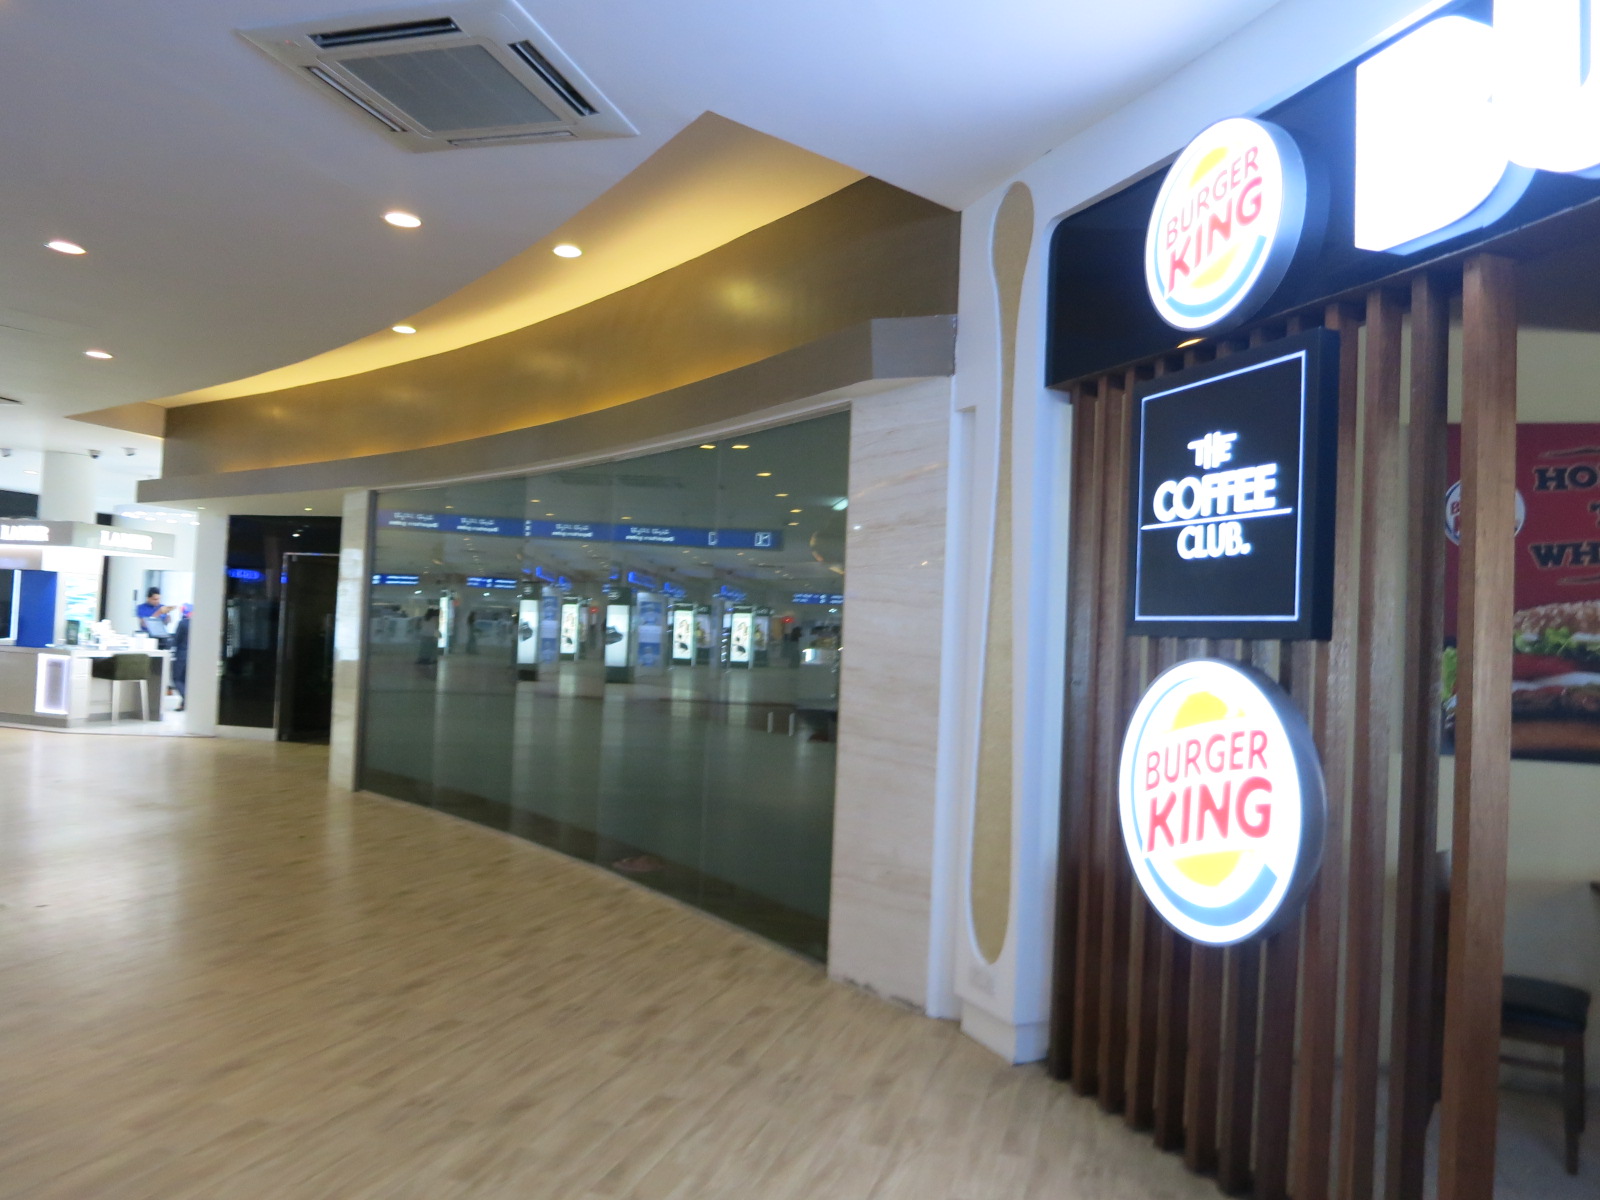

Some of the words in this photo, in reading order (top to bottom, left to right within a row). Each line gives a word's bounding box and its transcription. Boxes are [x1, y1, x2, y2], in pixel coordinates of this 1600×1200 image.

[1166, 146, 1259, 250] BURGER
[1168, 176, 1263, 294] KING
[1187, 430, 1238, 470] THE
[1153, 463, 1277, 522] COFFEE
[1177, 521, 1251, 560] CLUB.
[1145, 729, 1268, 791] BURGER
[1147, 776, 1273, 852] KING
